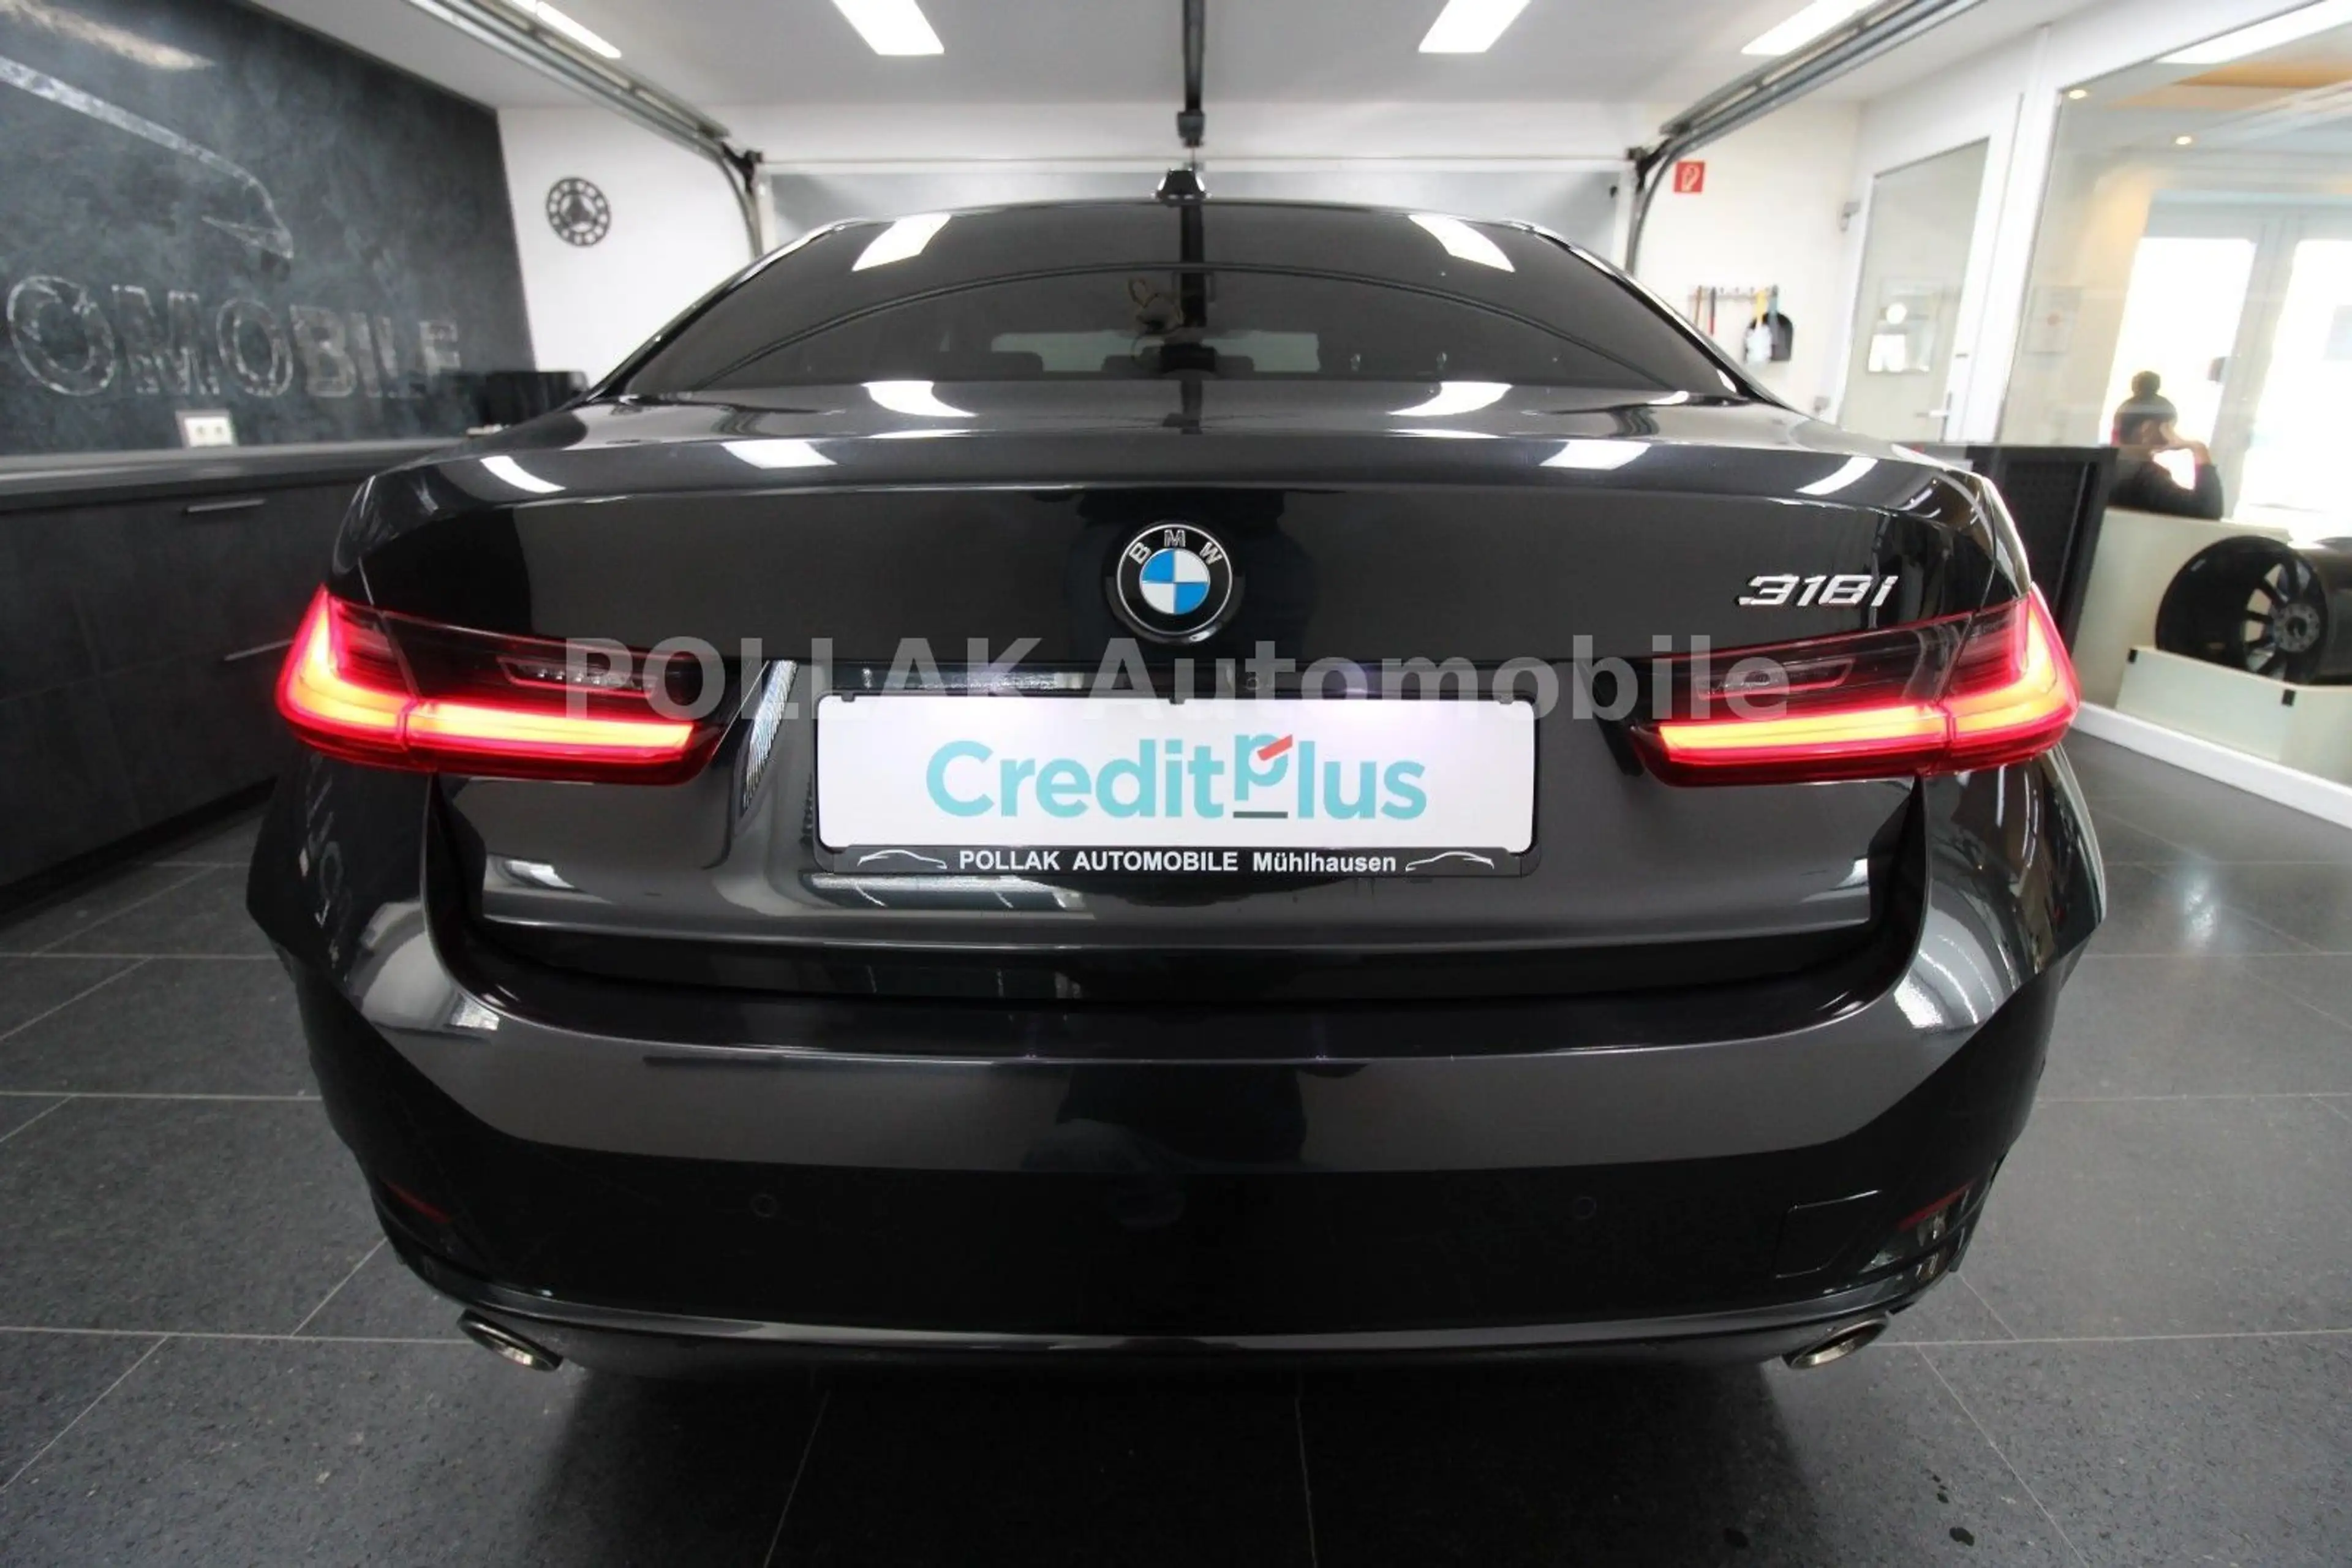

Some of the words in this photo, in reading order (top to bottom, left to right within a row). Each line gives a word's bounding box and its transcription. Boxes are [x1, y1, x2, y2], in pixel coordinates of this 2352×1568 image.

[1129, 529, 1224, 565] BMW
[1738, 573, 1899, 607] 318i
[959, 850, 1060, 870] POLLAK
[1072, 850, 1238, 872] AUTOMOBILE
[1253, 851, 1396, 873] Mühlhausen
